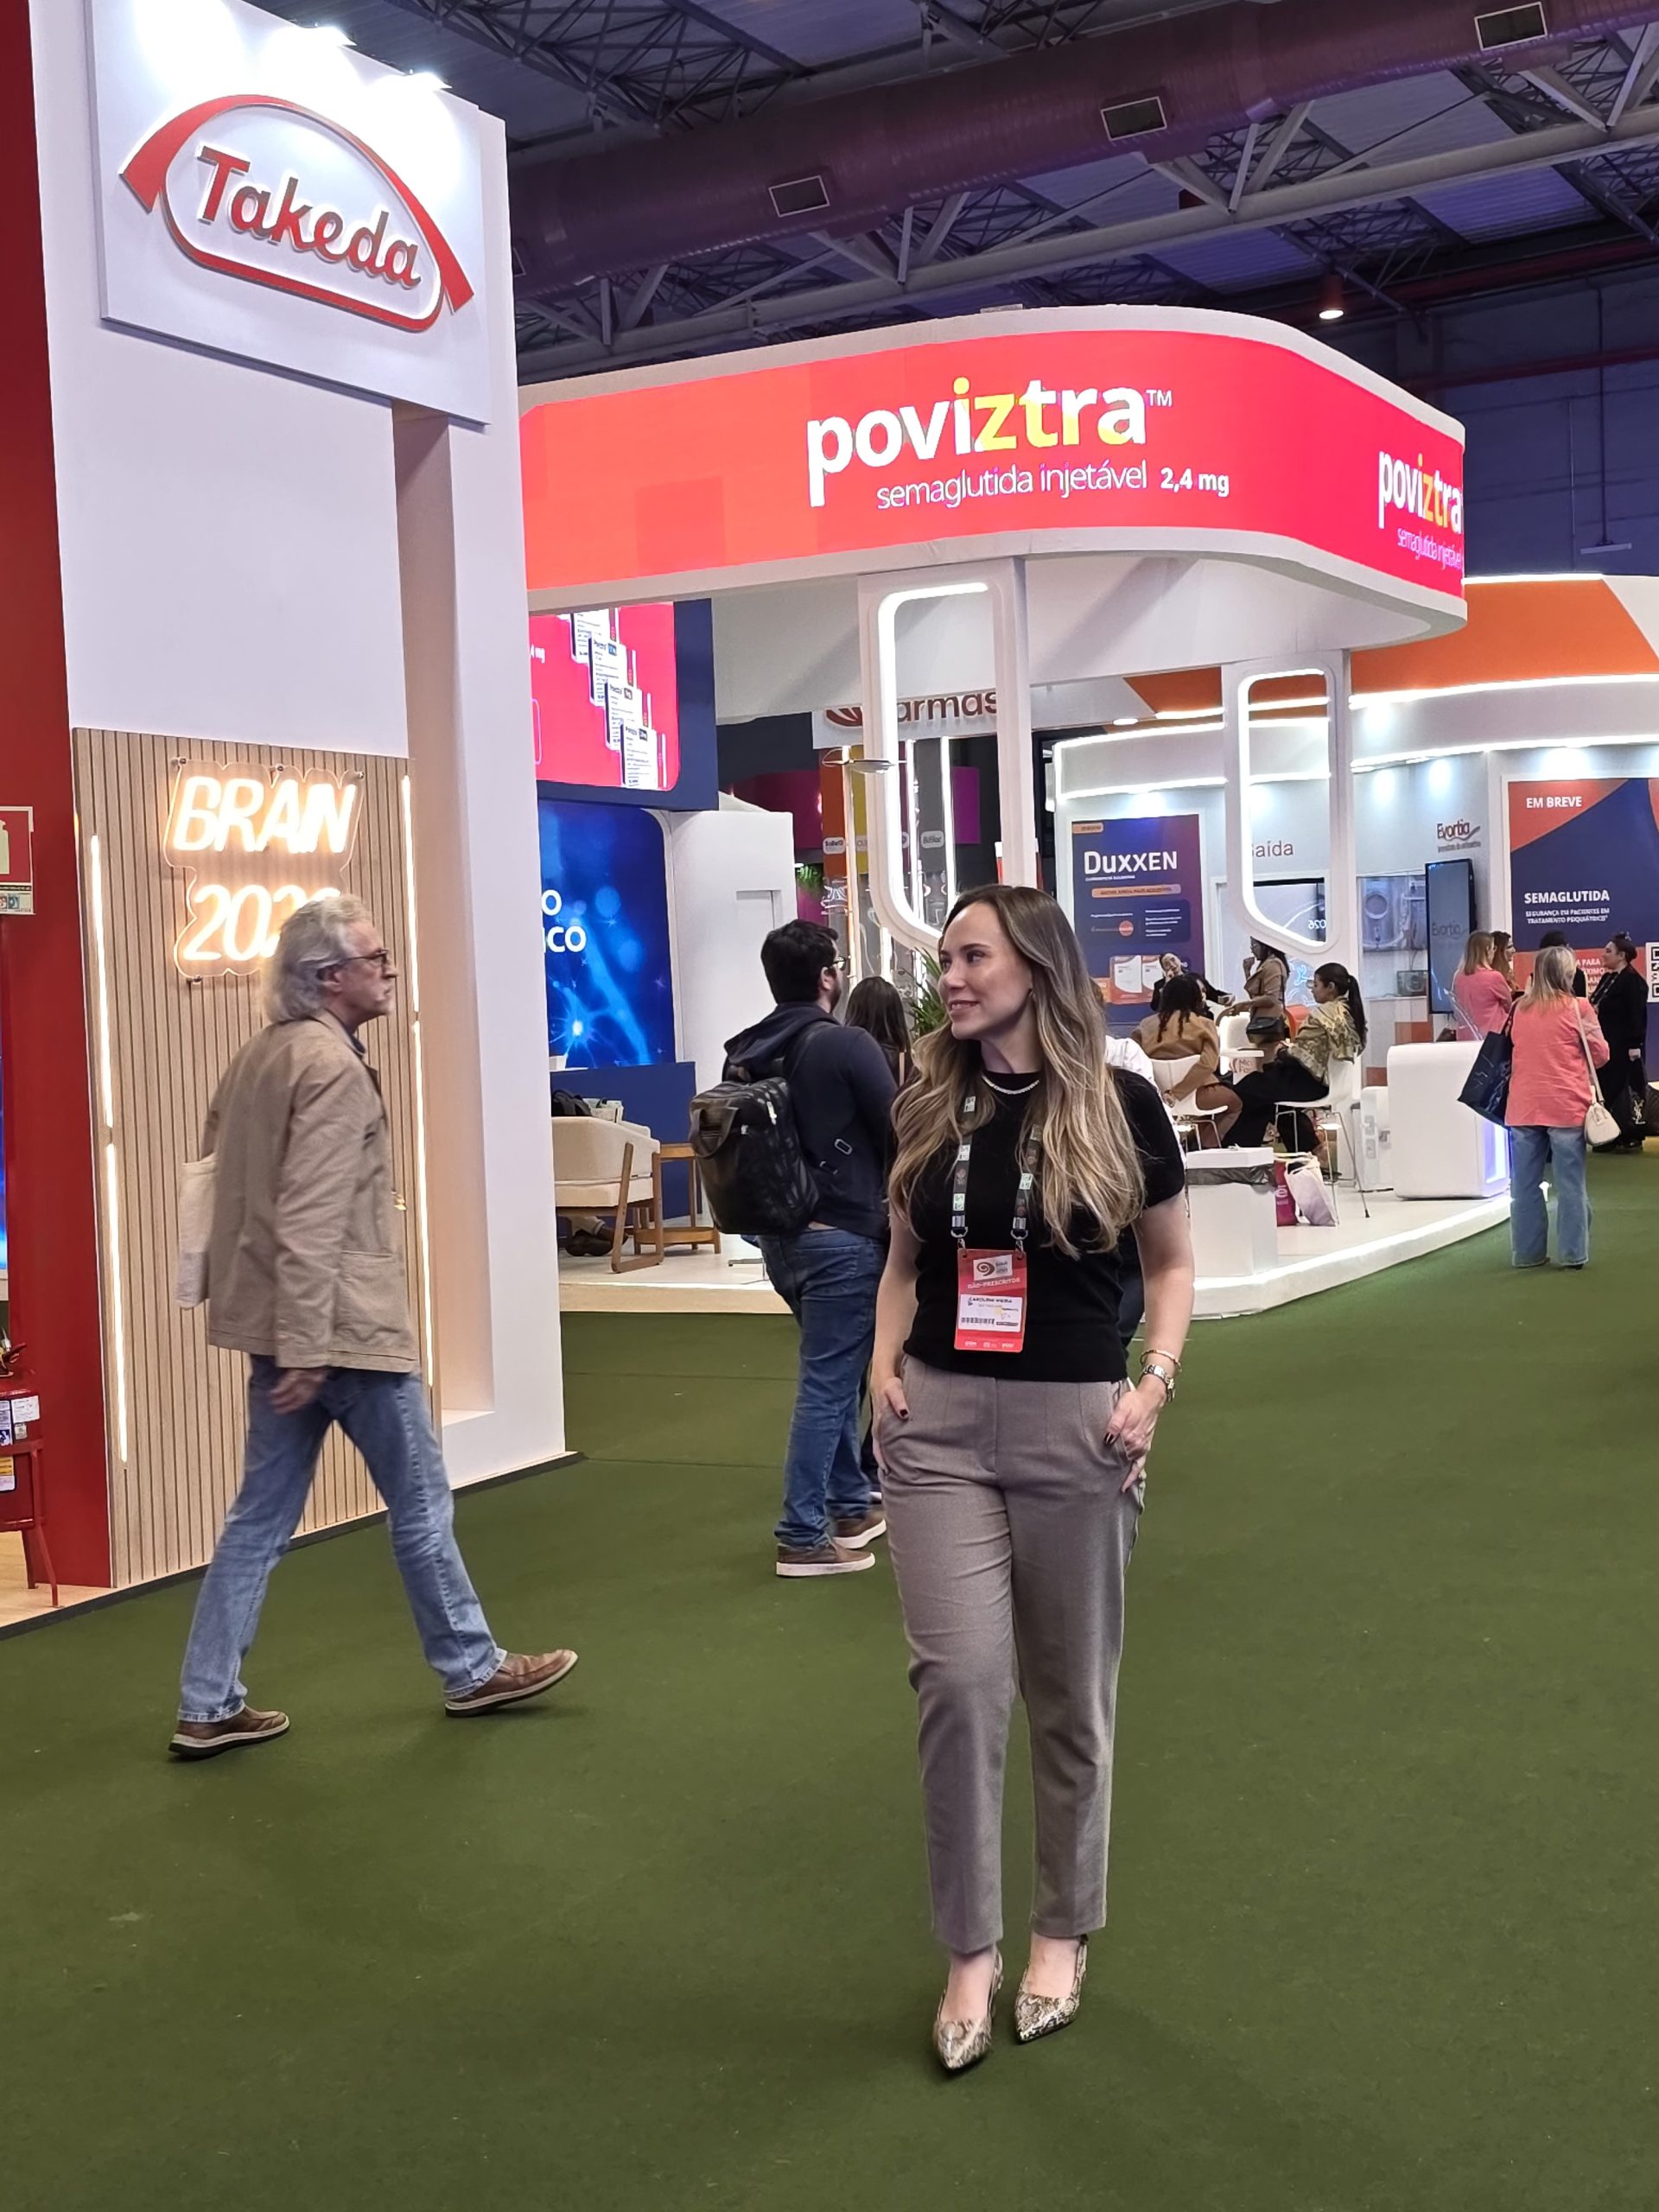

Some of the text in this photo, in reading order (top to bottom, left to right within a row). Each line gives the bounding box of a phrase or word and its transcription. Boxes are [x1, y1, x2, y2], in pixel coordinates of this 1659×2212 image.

[197, 144, 423, 289] Takeda
[877, 460, 1230, 510] semaglutida injetável 2,4 mg
[897, 691, 996, 722] armas
[1526, 796, 1583, 809] EM BREVE
[1524, 889, 1610, 905] SEMAGLUTIDA
